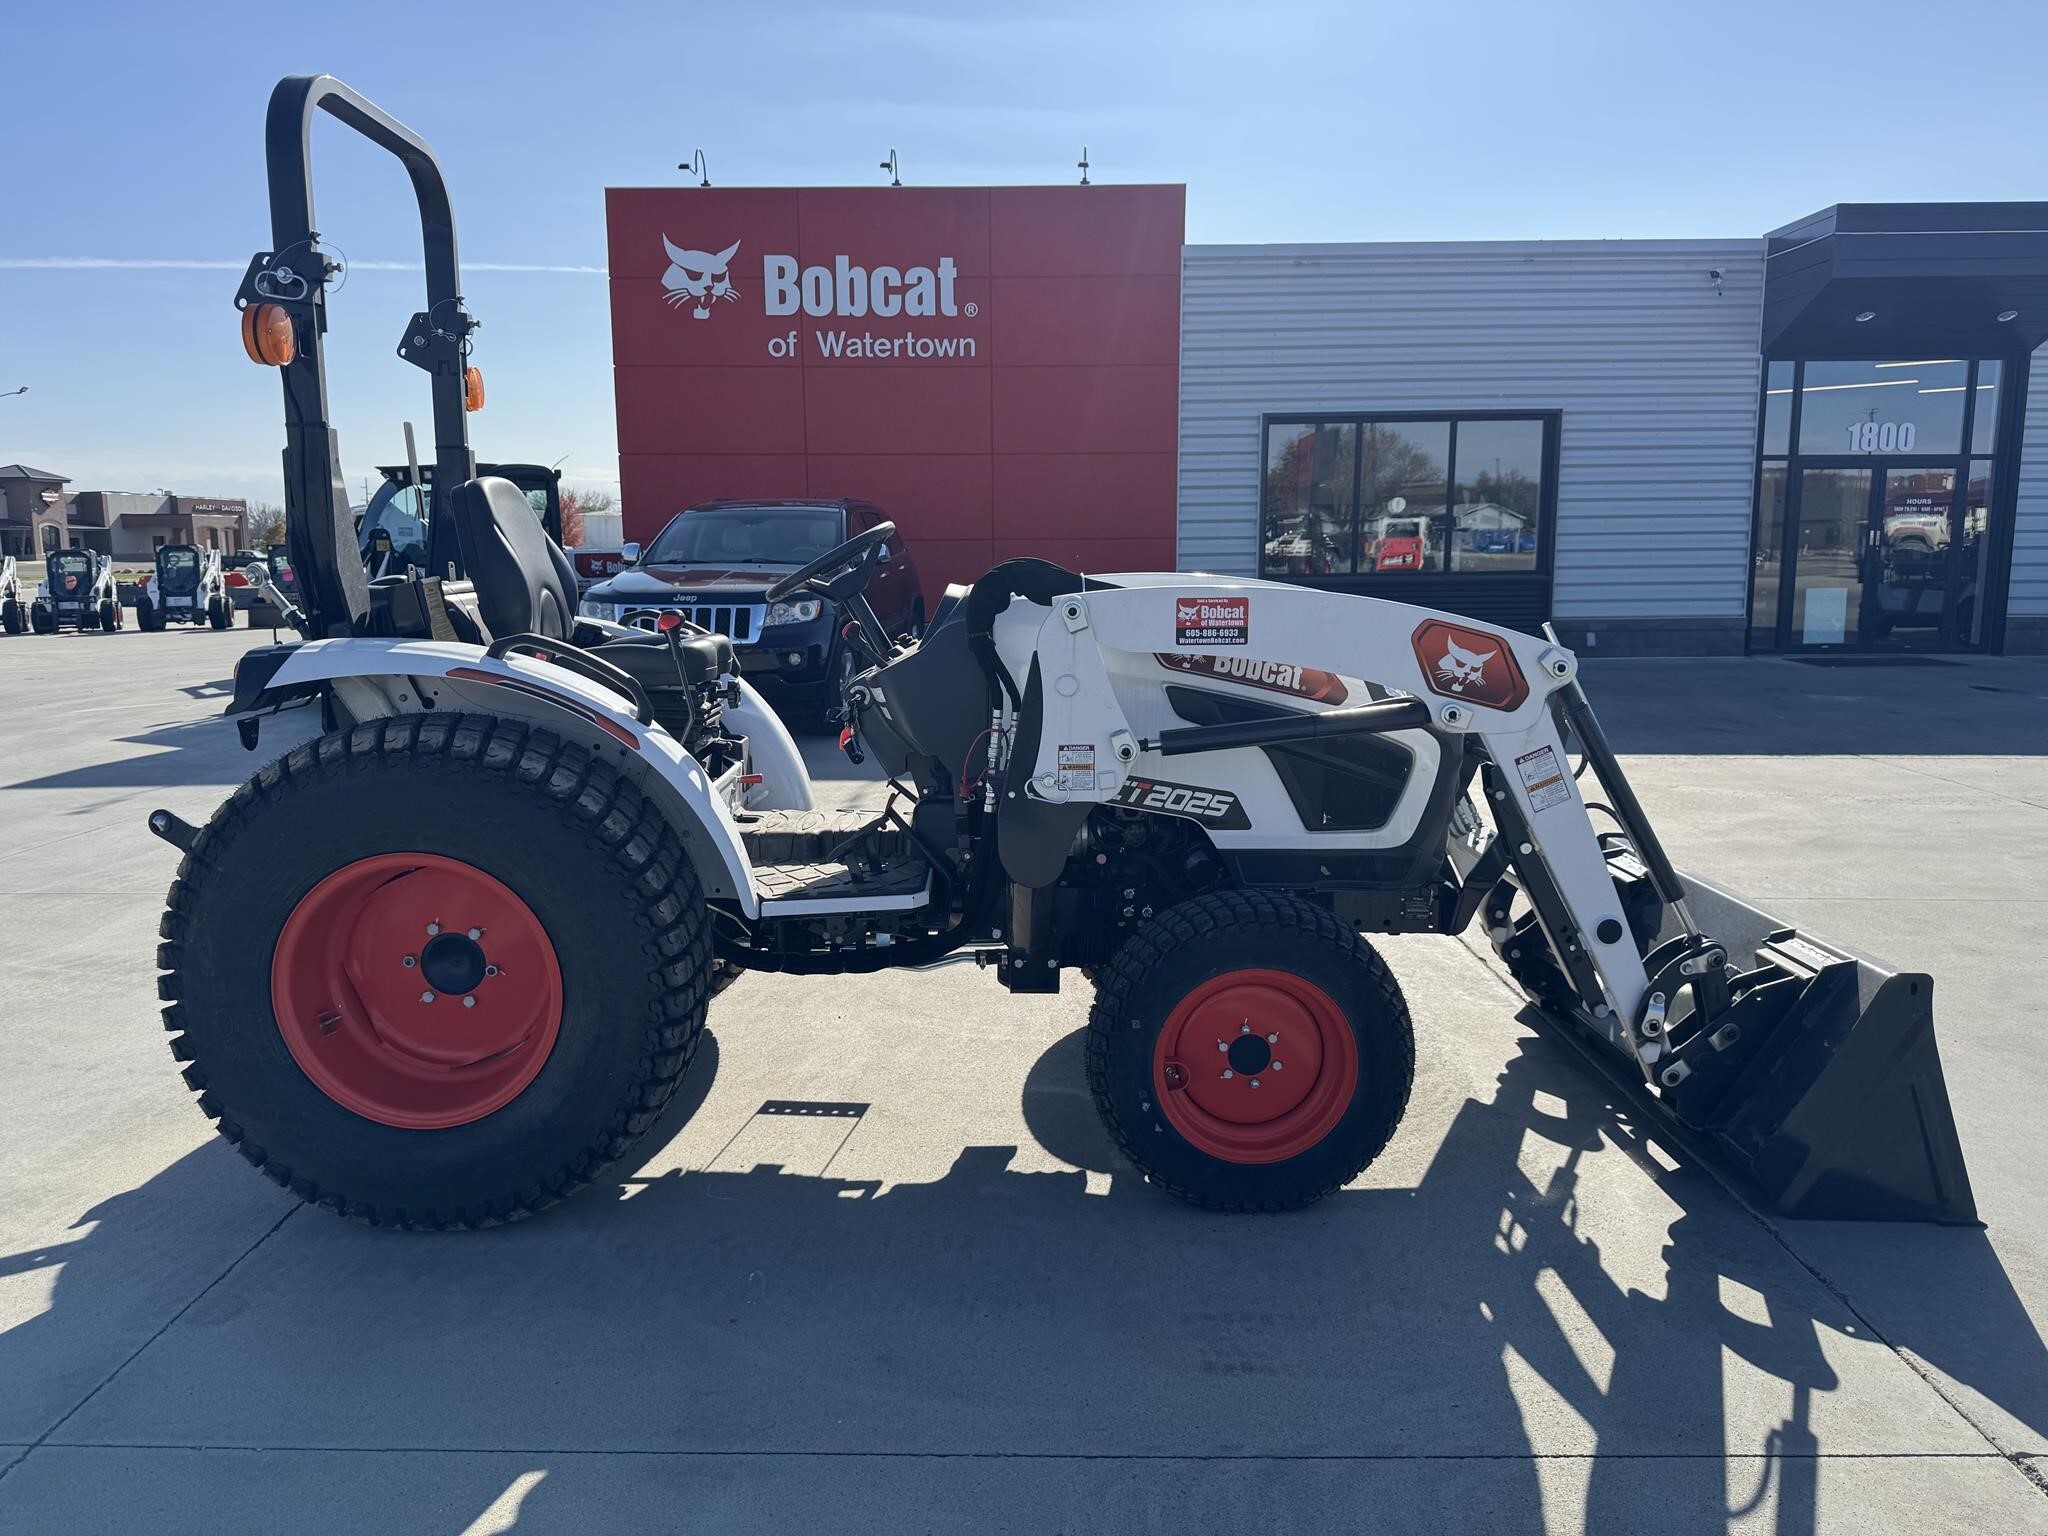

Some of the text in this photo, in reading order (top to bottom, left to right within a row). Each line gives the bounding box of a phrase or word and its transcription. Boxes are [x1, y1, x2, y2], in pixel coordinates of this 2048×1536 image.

[763, 254, 958, 317] Bobcat
[767, 330, 976, 358] of Watertown
[1847, 422, 1915, 452] 1800
[673, 594, 697, 603] Jeep
[1201, 605, 1244, 619] Bobcat
[1185, 629, 1239, 637] 605-886-6933
[1524, 747, 1549, 761] DANGER
